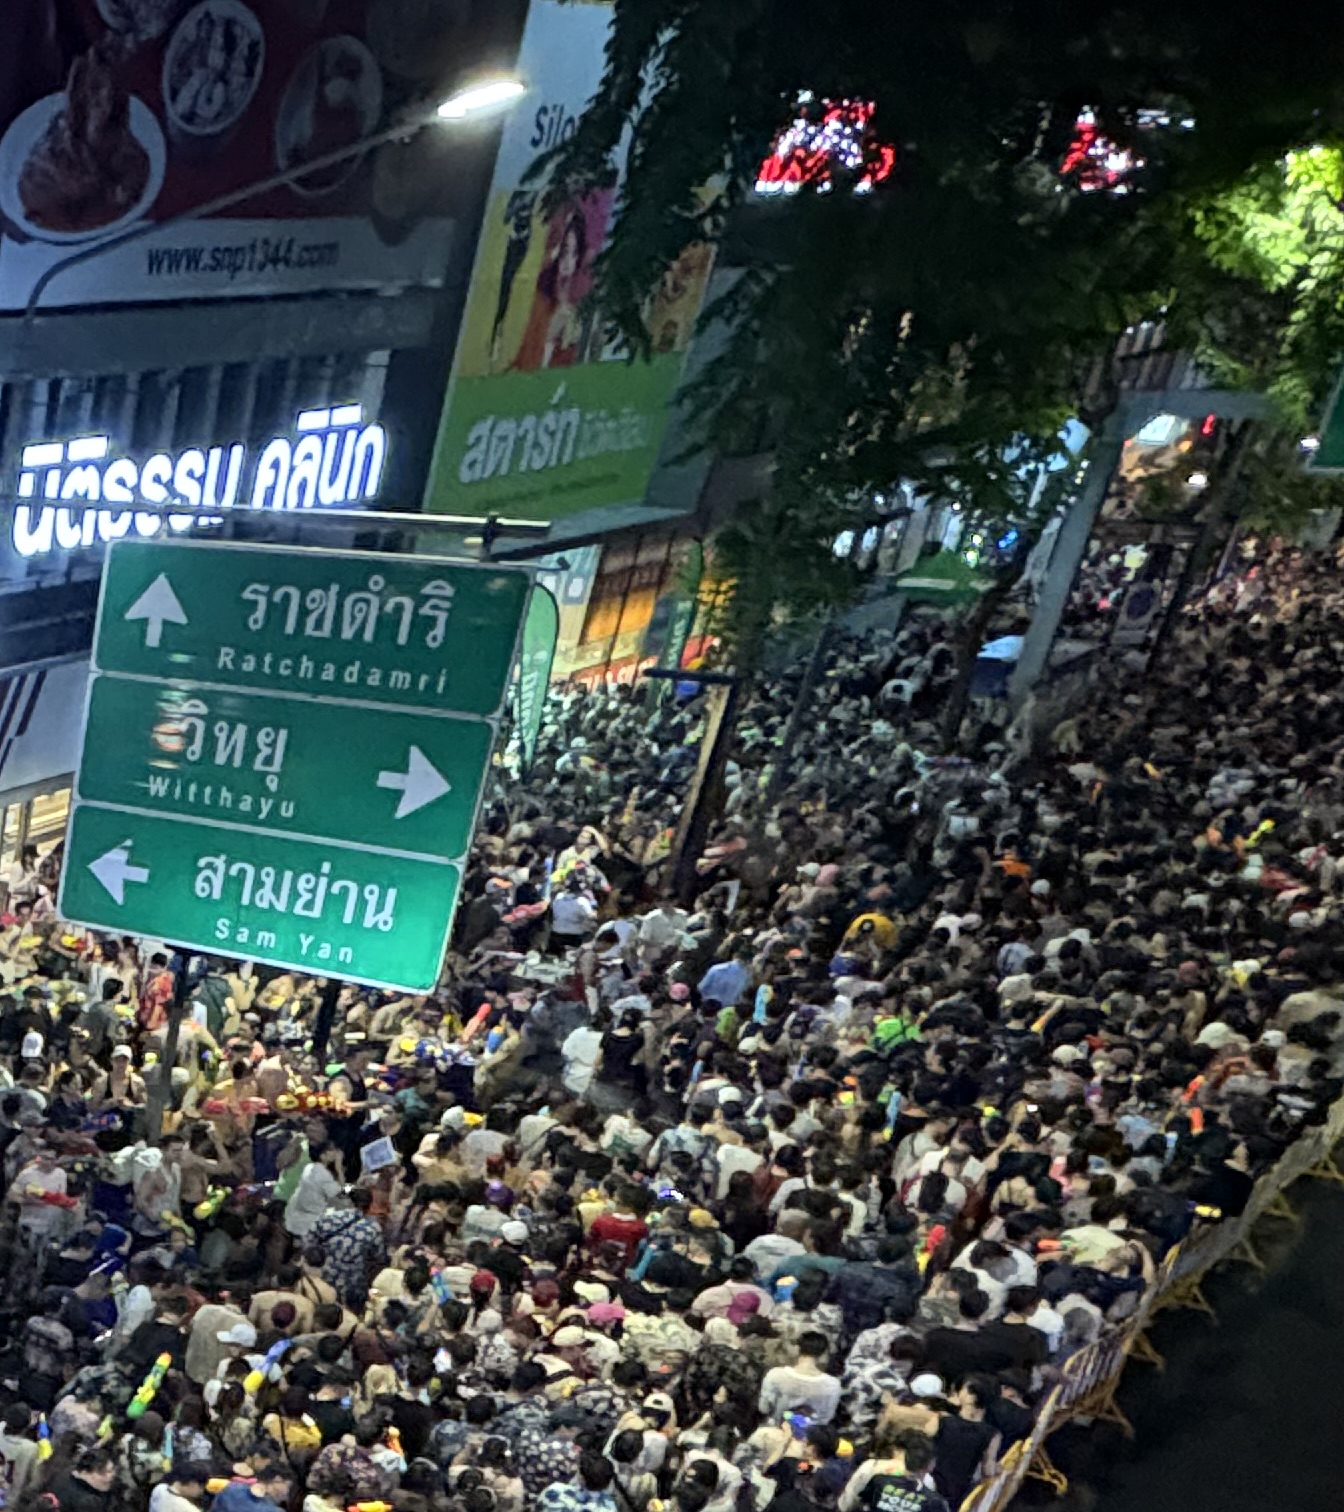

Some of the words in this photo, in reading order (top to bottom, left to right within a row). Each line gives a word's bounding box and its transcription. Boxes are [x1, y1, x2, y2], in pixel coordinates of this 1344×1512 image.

[530, 103, 578, 147] Silo
[241, 574, 455, 649] ราชดำริ
[217, 647, 448, 694] Ratchadamri
[176, 699, 288, 793] วิทยุ
[148, 775, 295, 820] Witthayu
[194, 854, 398, 933] สามย่าน
[215, 917, 276, 949] Sam
[299, 933, 353, 963] Yan
